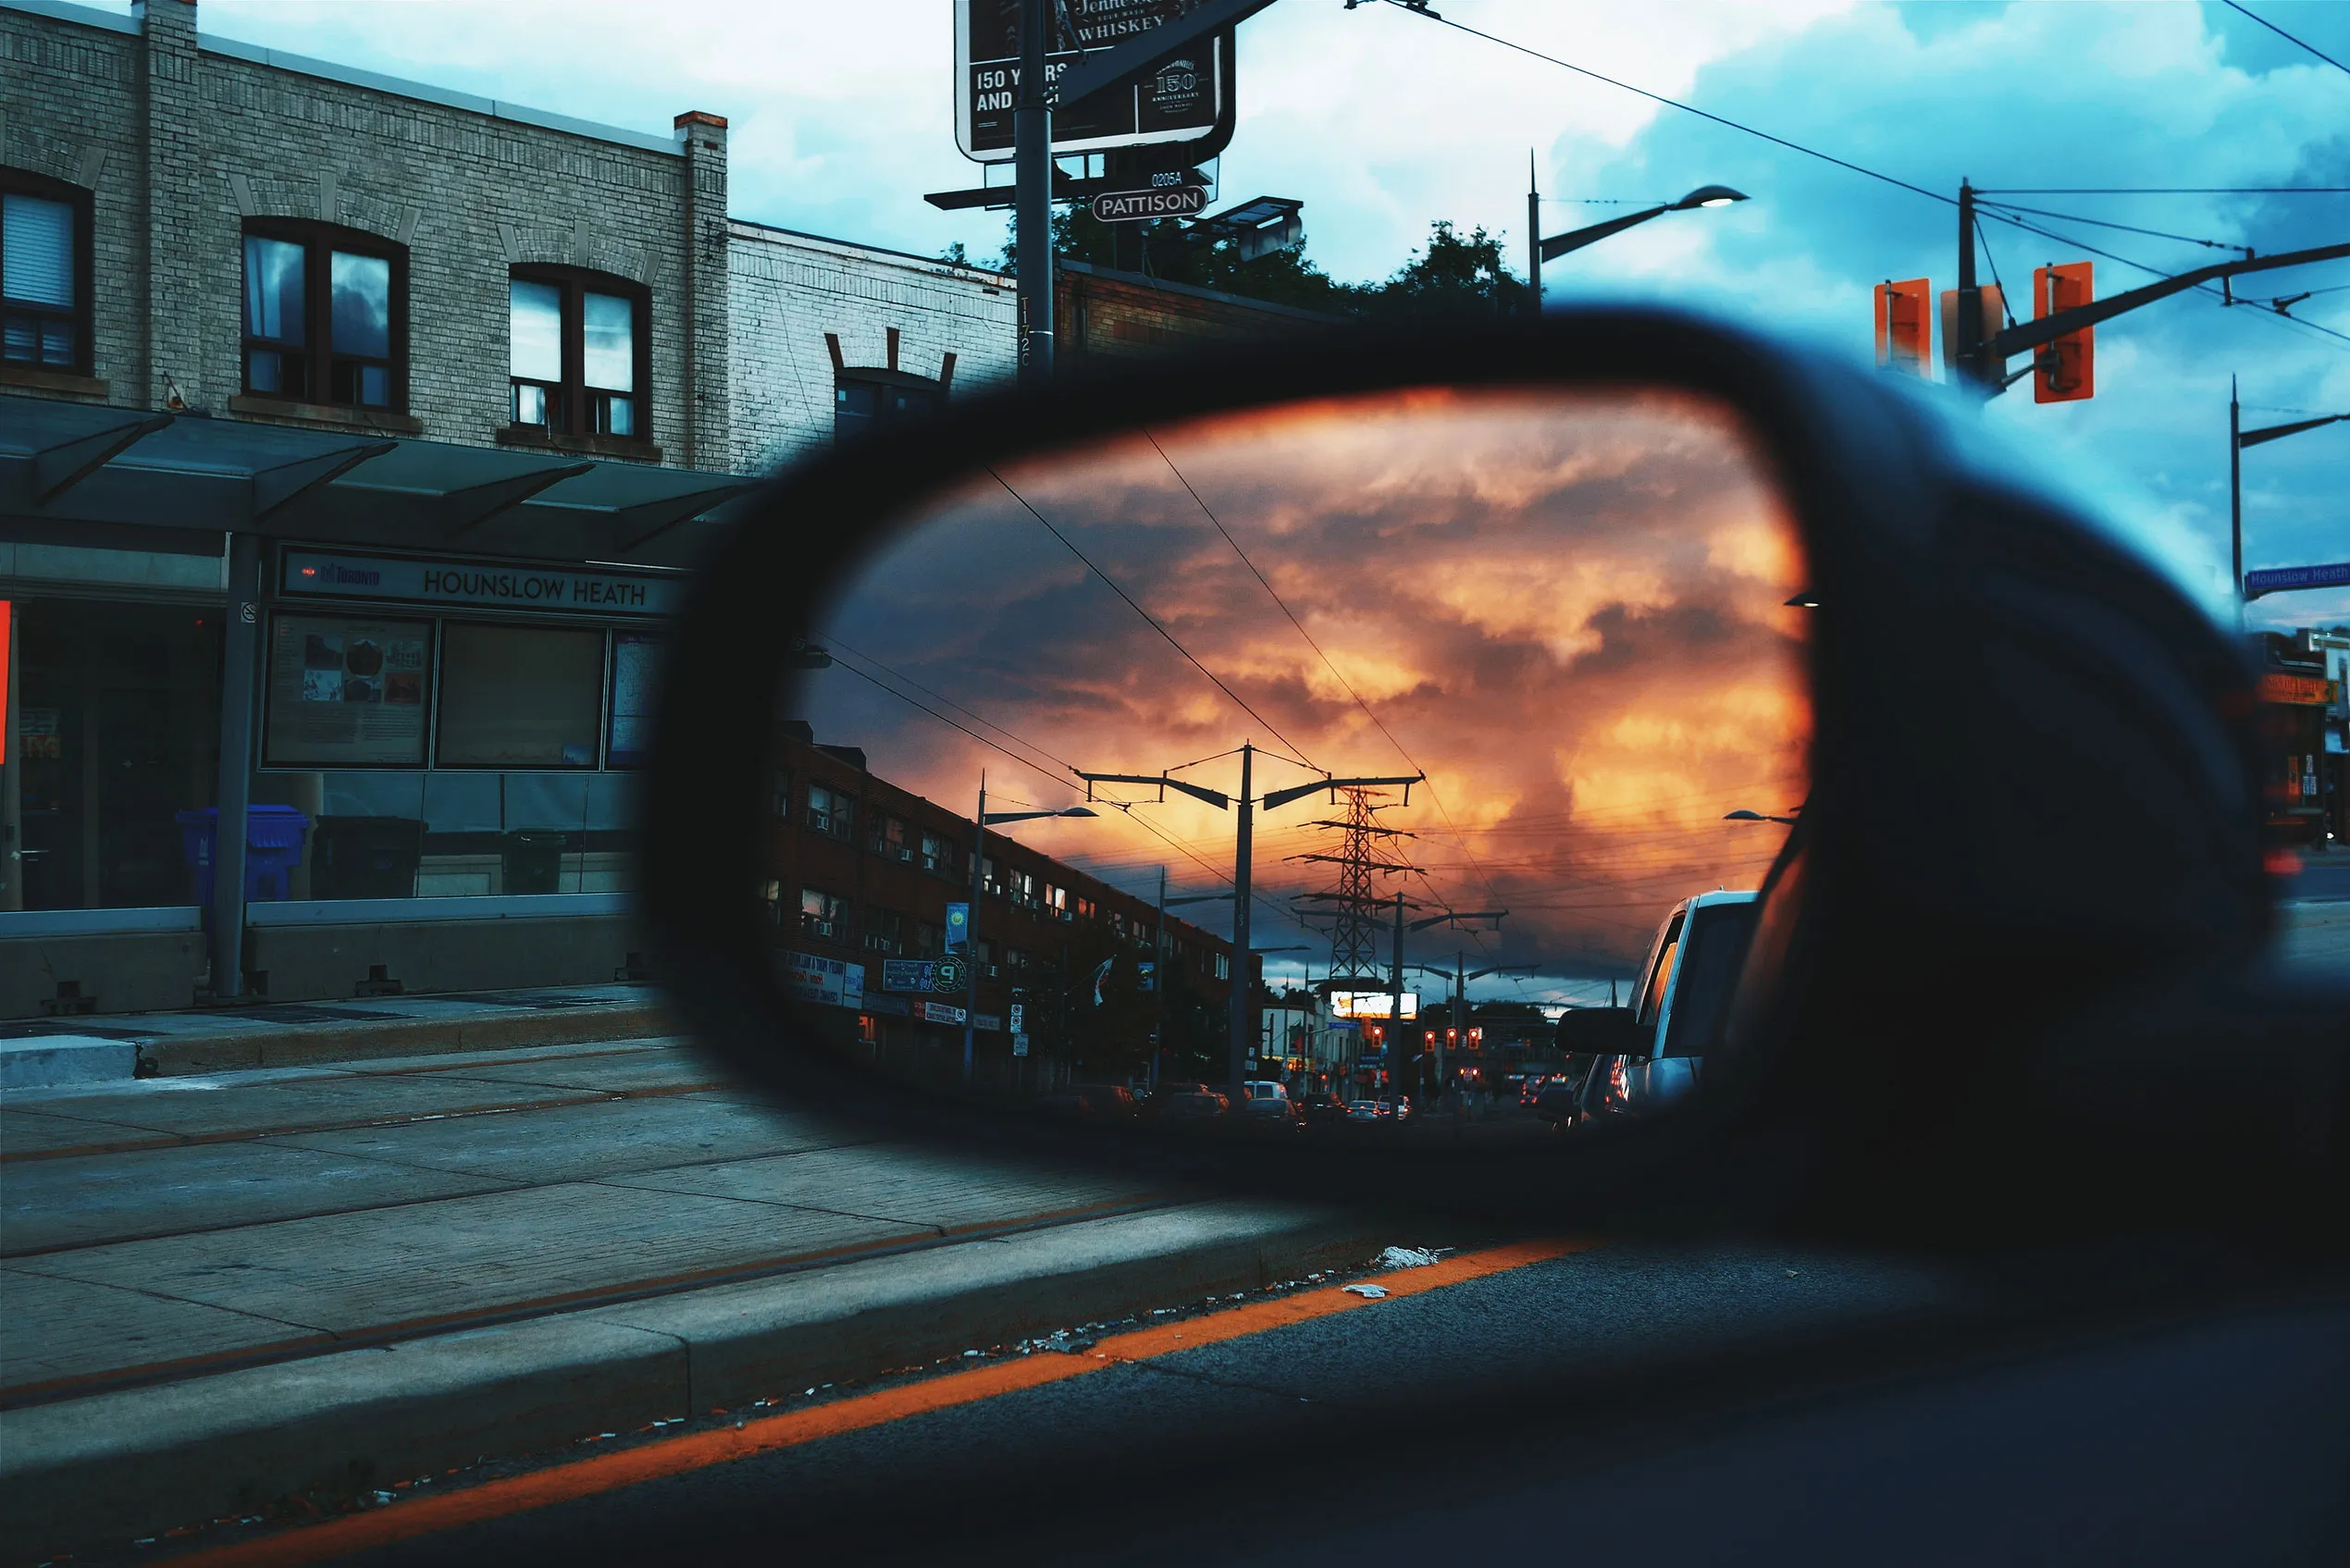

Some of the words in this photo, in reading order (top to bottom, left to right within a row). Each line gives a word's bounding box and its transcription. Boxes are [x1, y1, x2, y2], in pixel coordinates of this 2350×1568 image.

[1078, 14, 1166, 42] WHISKEY
[977, 69, 1005, 90] 150
[1011, 62, 1068, 86] YRS
[1156, 73, 1196, 93] 150
[977, 91, 1013, 111] AND
[1151, 171, 1182, 187] 0205A
[1102, 192, 1198, 216] PATTISON
[337, 565, 379, 586] TORONTO
[2251, 571, 2308, 585] Hounslow
[2313, 567, 2348, 581] Heath
[424, 570, 564, 600] HOUNSLOW
[574, 580, 647, 606] HEATH
